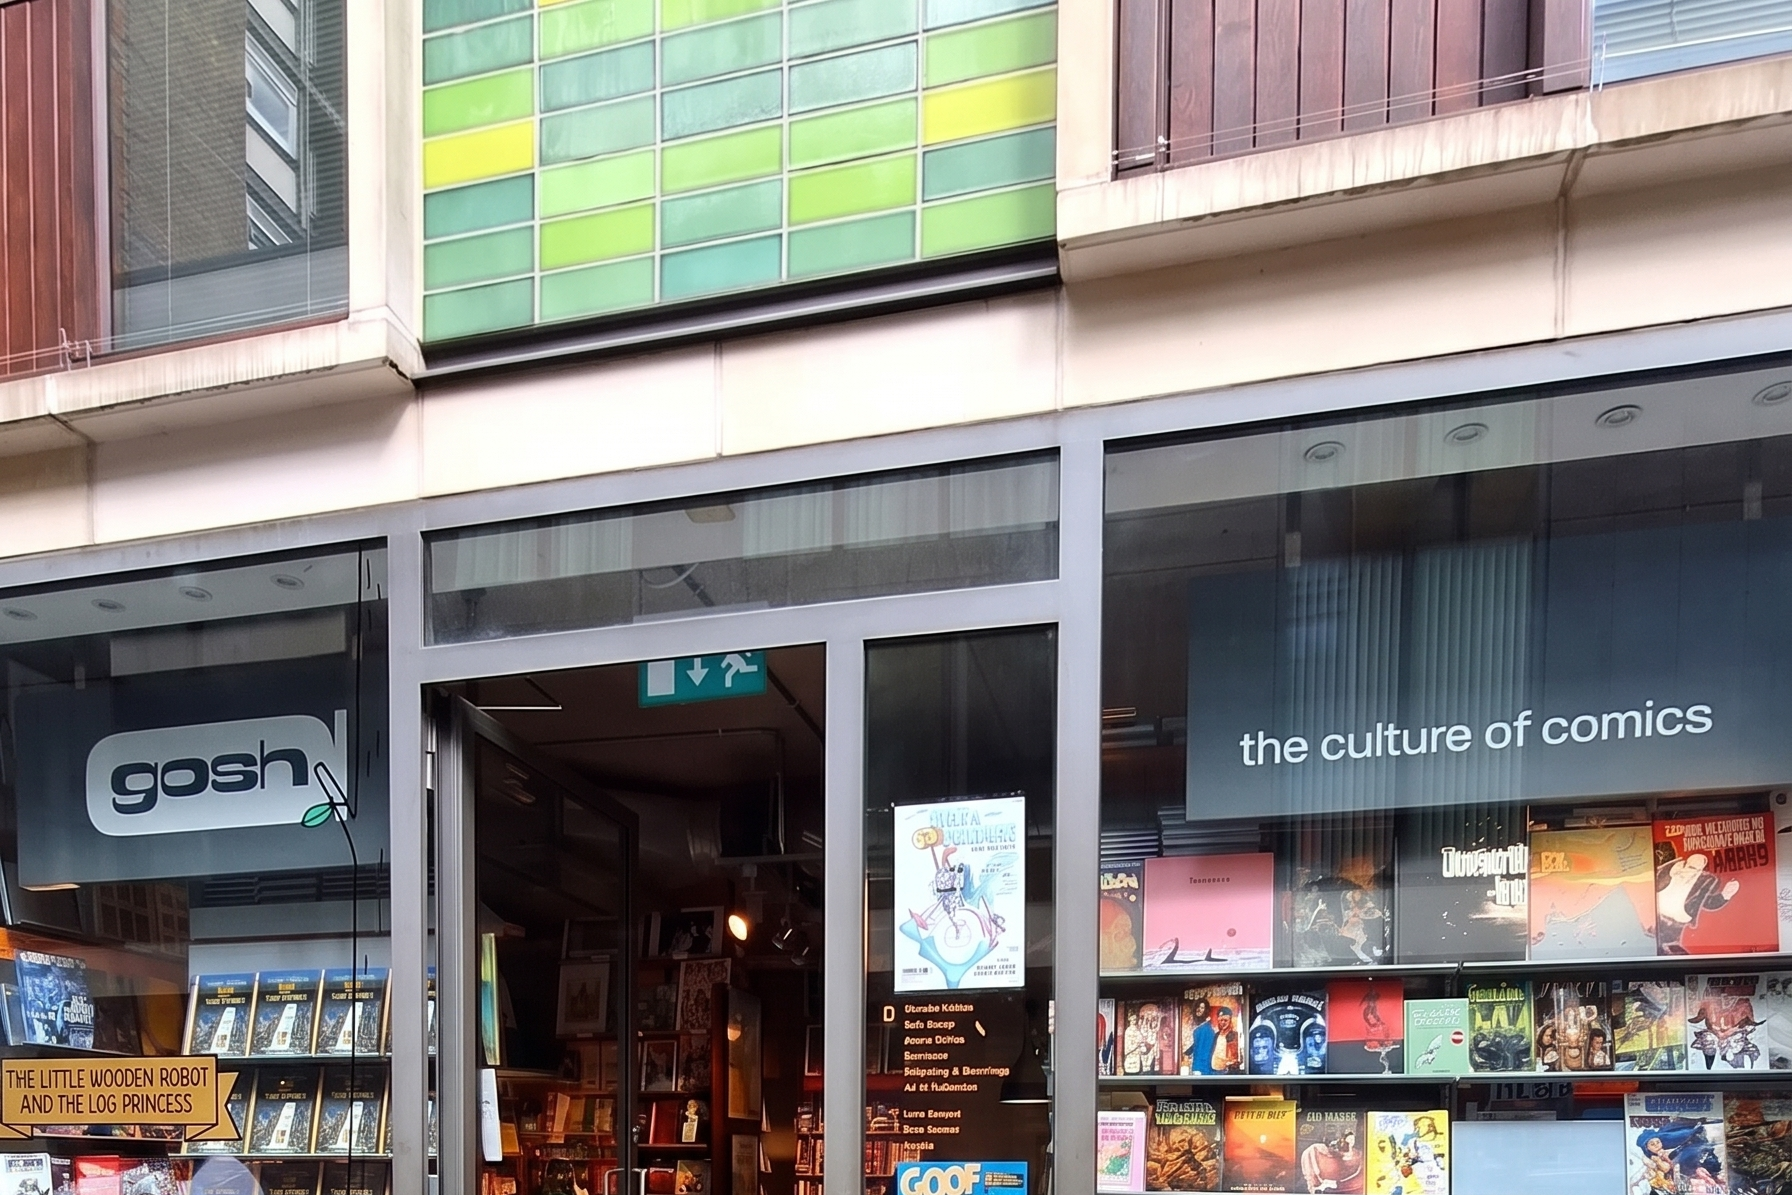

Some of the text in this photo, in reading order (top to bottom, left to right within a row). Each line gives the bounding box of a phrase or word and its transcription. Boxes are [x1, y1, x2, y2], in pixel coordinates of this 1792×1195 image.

[1239, 700, 1714, 767] the culture of comics
[5, 1066, 209, 1089] THE LITTLE WOODEN ROBOT
[20, 1093, 193, 1114] AND THE LOG PRINCESS
